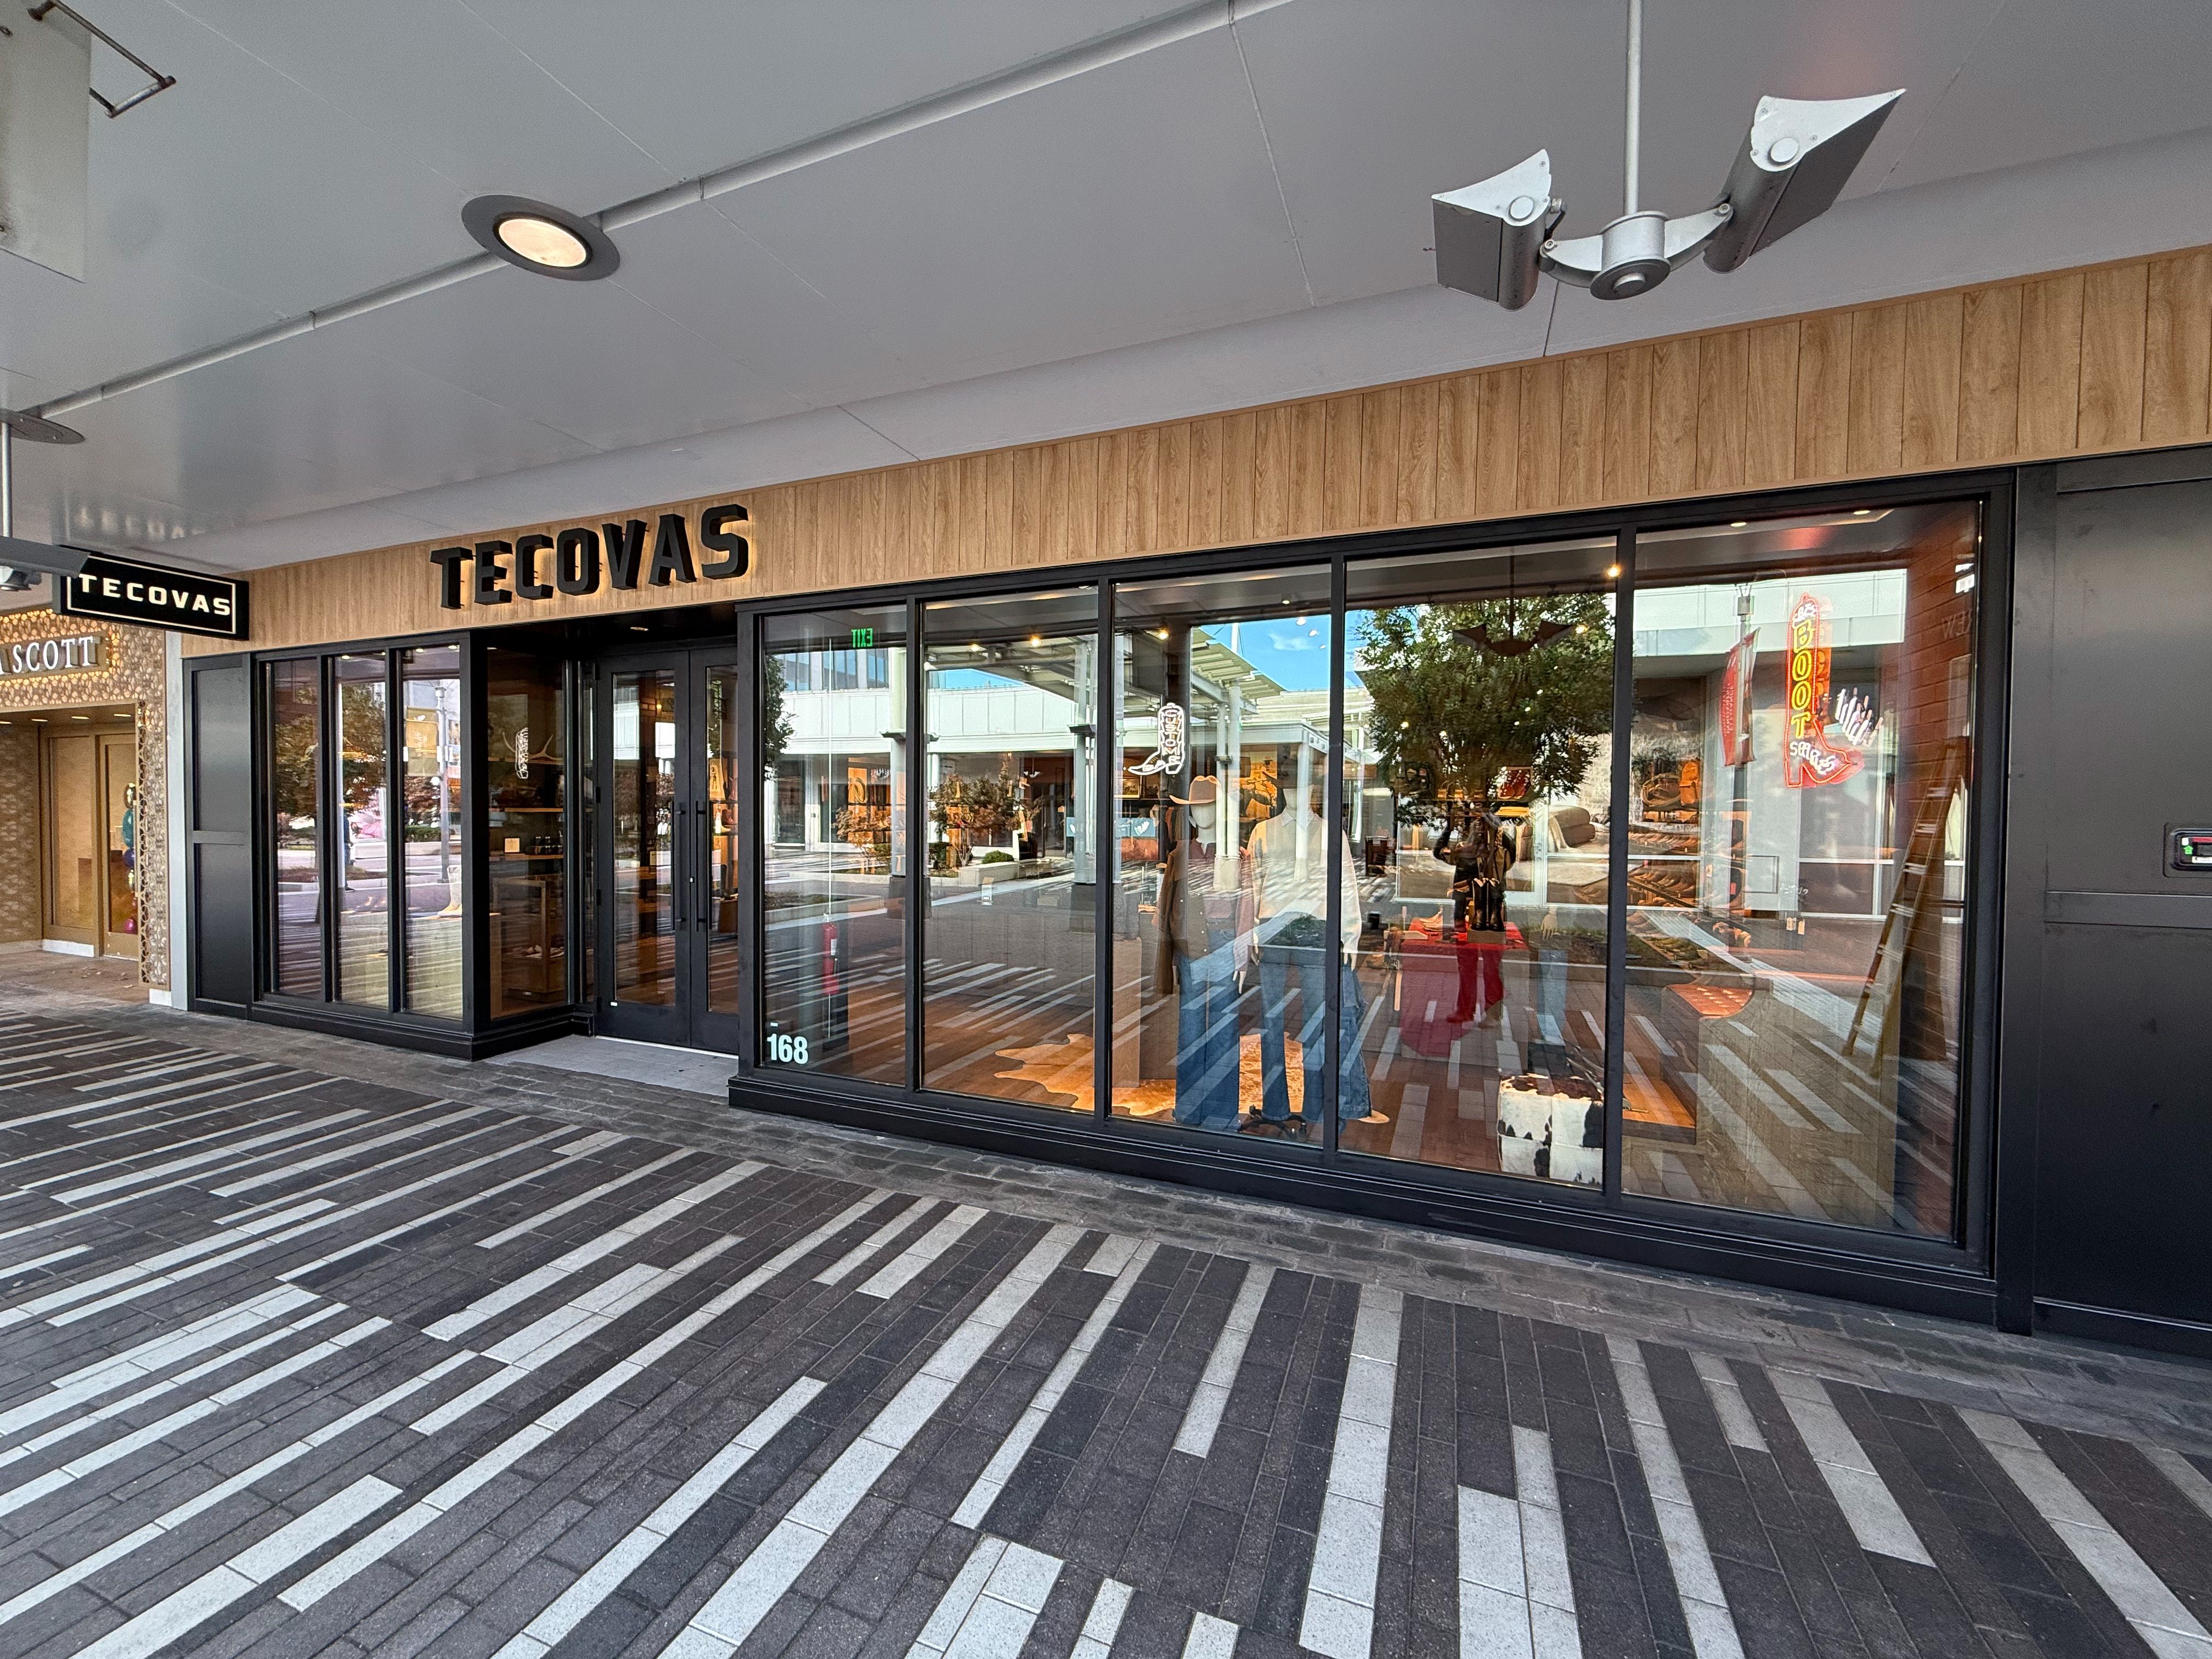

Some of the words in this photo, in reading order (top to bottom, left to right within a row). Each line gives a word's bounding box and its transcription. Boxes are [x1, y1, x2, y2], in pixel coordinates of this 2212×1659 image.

[430, 504, 749, 610] TECOVAS
[79, 574, 230, 616] TECOVAS
[13, 636, 93, 673] SCOTT
[1791, 619, 1814, 738] BOOT
[767, 1034, 808, 1064] 168
